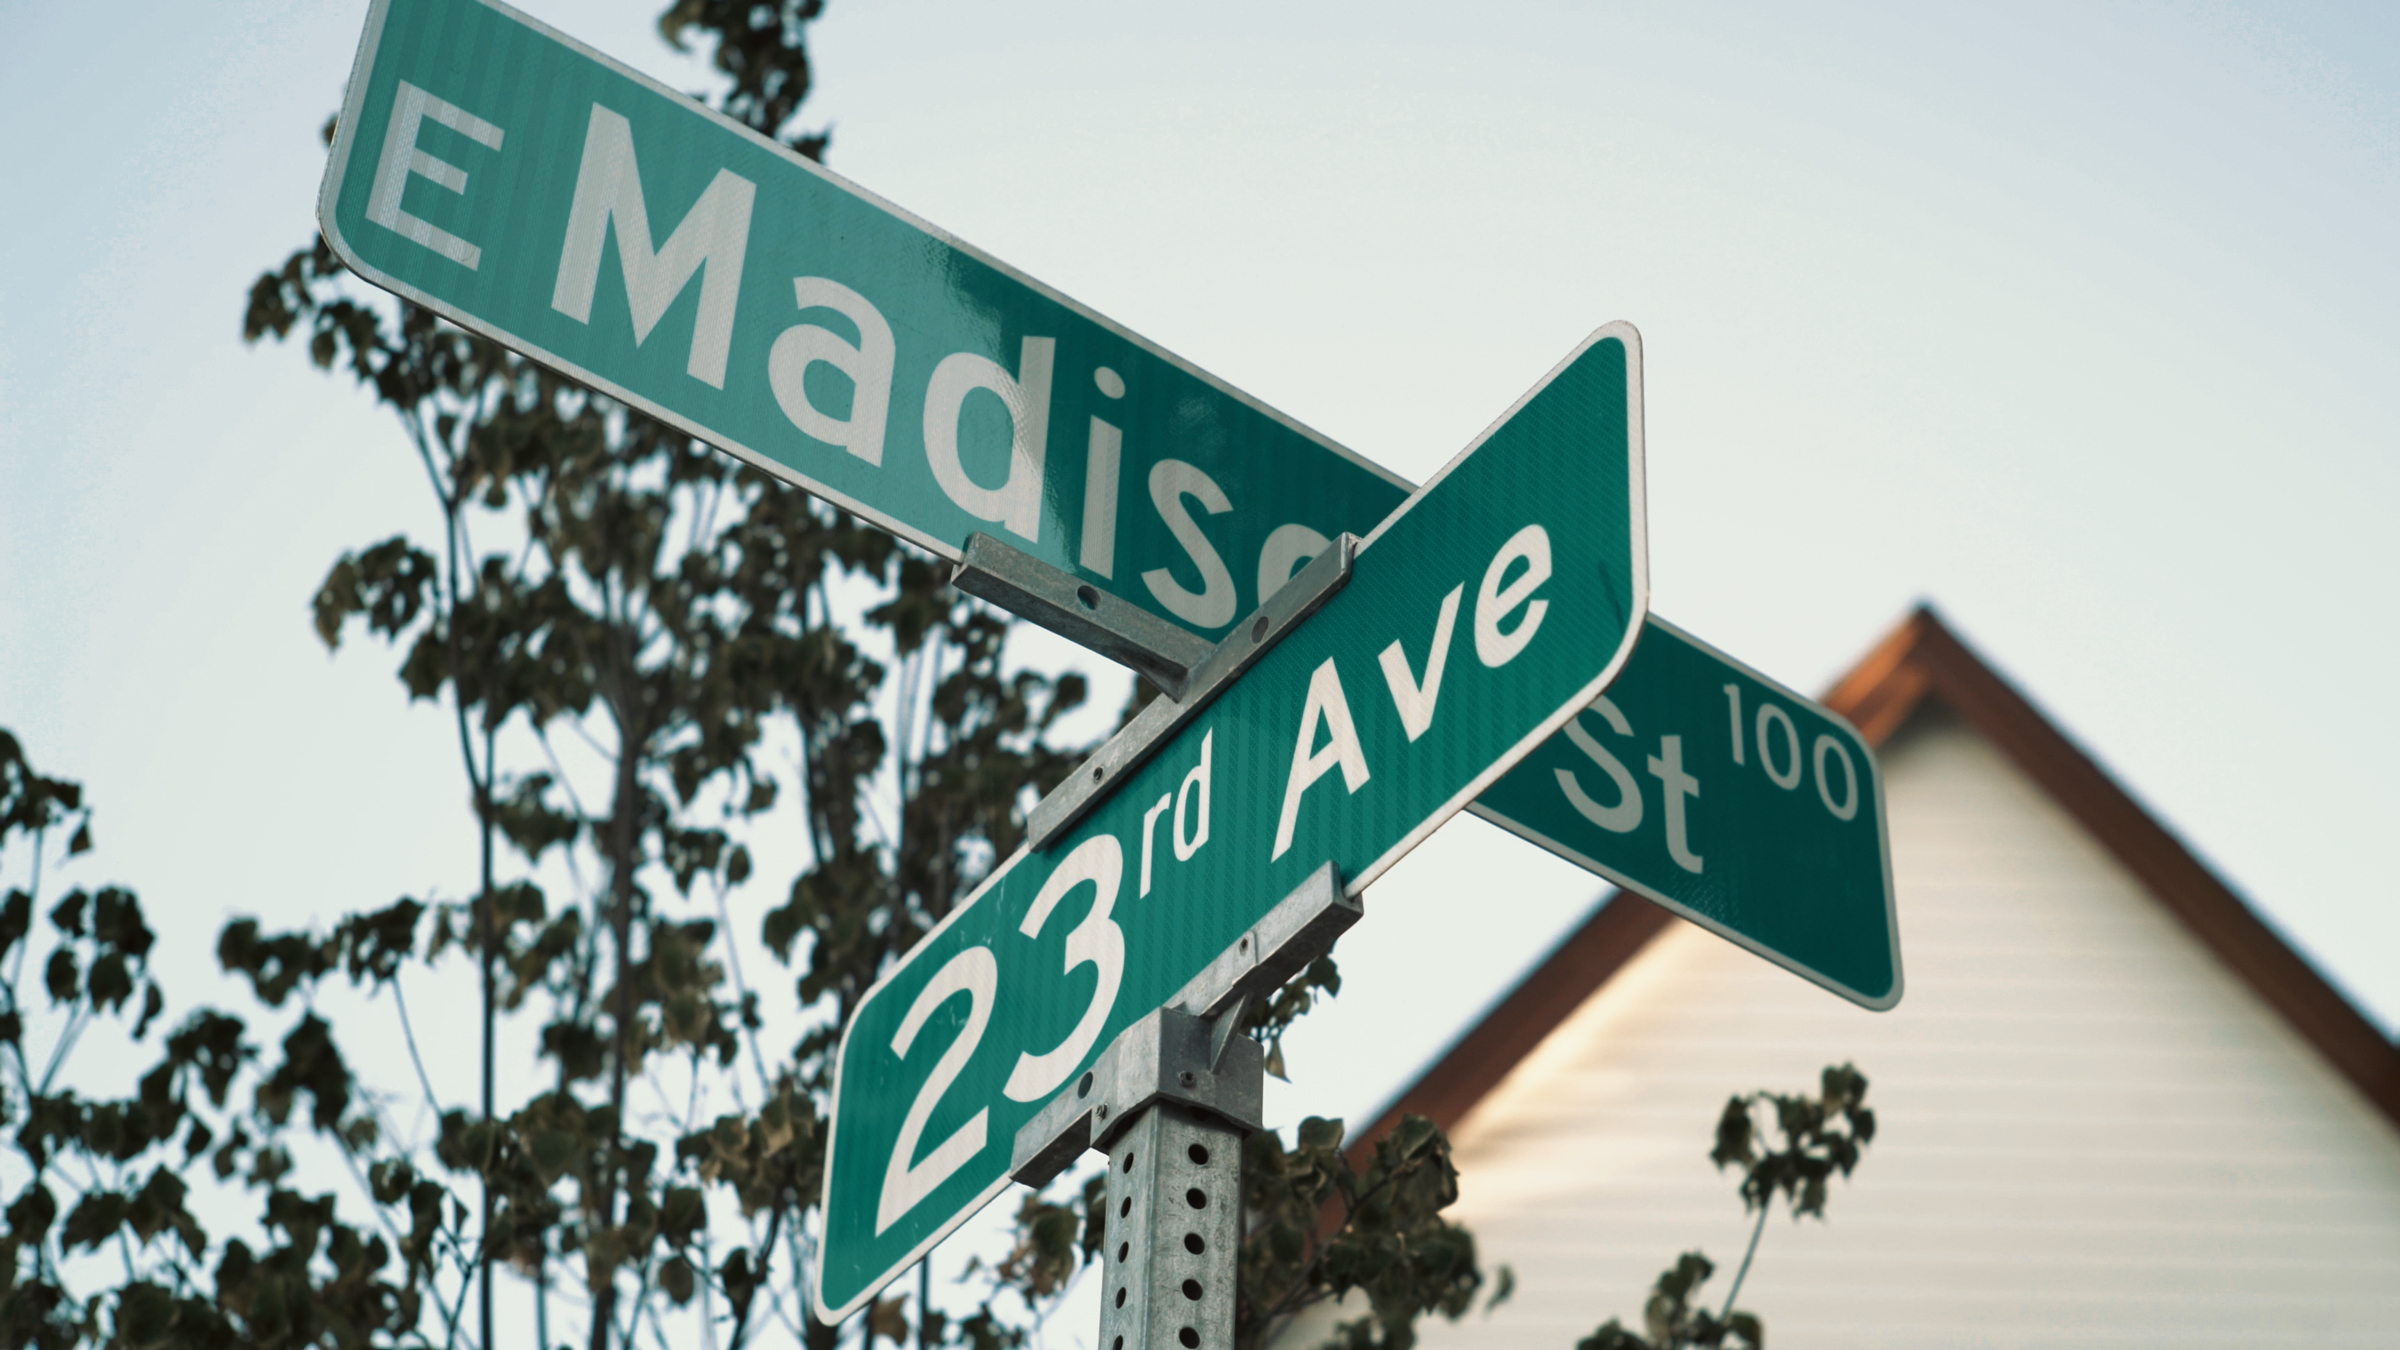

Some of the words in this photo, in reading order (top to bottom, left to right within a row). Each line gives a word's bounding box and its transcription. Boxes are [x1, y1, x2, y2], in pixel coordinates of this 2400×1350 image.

[364, 78, 506, 272] E
[1552, 693, 1704, 875] St
[1723, 683, 1860, 822] 100
[875, 726, 1213, 1239] 23rd
[1270, 523, 1553, 864] Ave
